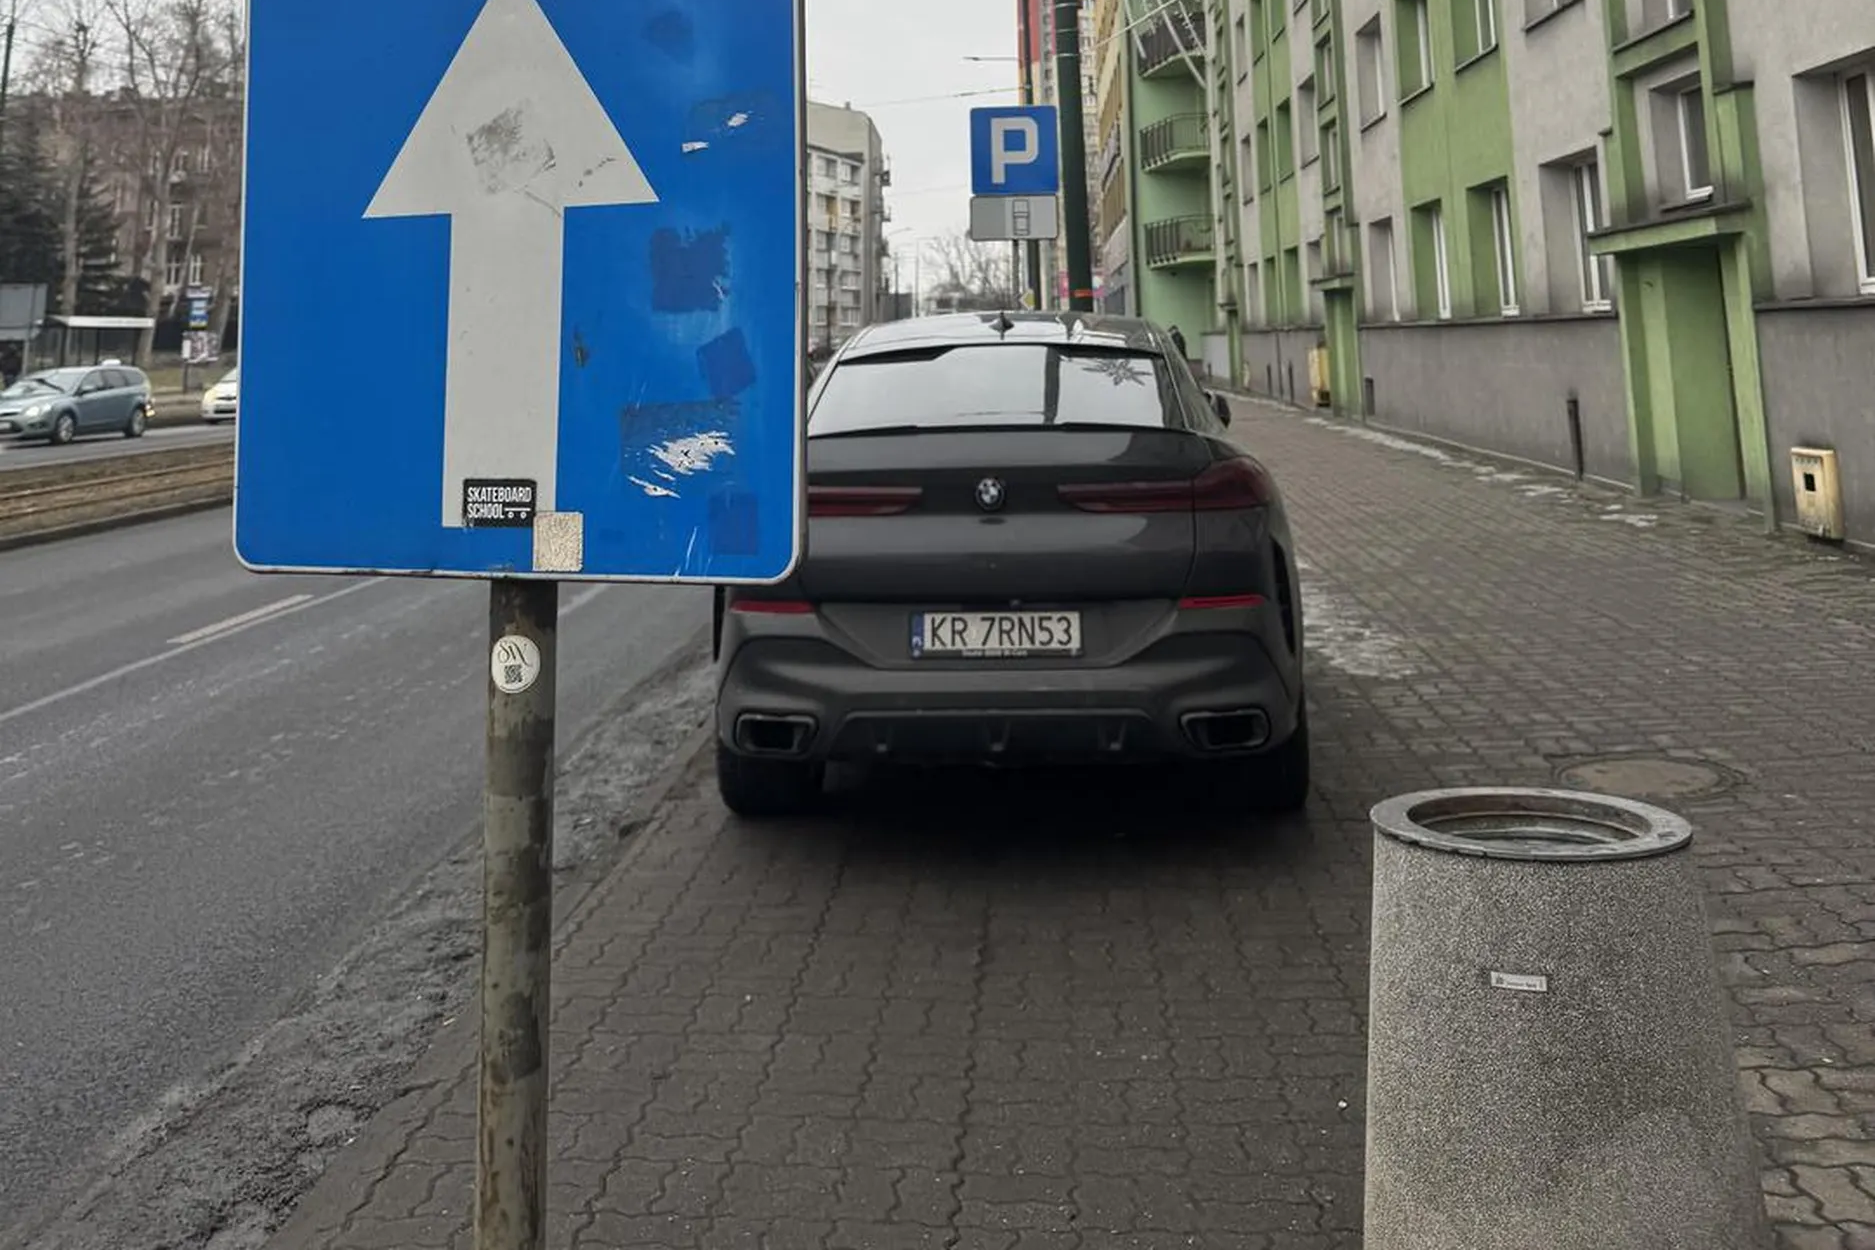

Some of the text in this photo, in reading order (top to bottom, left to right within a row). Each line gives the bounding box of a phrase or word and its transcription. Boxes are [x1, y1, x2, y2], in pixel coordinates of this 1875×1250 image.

[990, 116, 1039, 184] P
[467, 486, 532, 502] SKATEBOARD
[467, 503, 505, 519] SCHOOL
[931, 616, 968, 647] KR
[980, 616, 1072, 647] 7RN53
